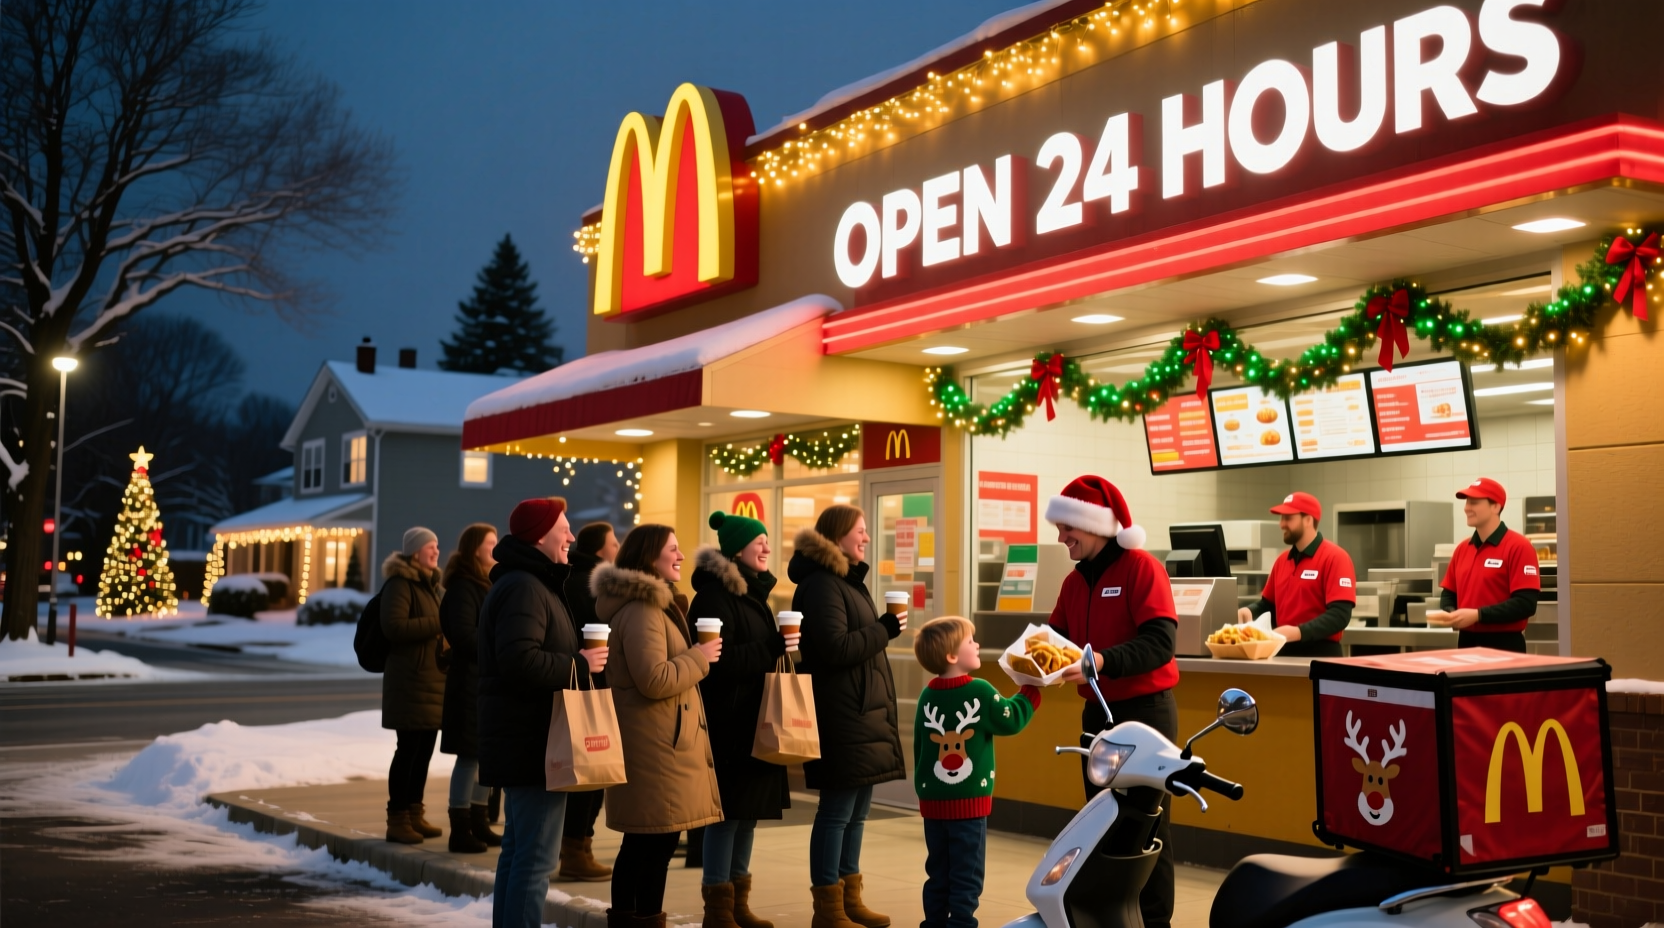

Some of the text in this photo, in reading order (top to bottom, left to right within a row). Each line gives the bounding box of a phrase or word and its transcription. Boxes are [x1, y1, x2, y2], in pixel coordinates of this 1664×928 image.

[594, 82, 722, 315] M
[833, 0, 1560, 288] OPEN 24 HOURS
[885, 429, 911, 461] M
[1484, 718, 1586, 824] M
